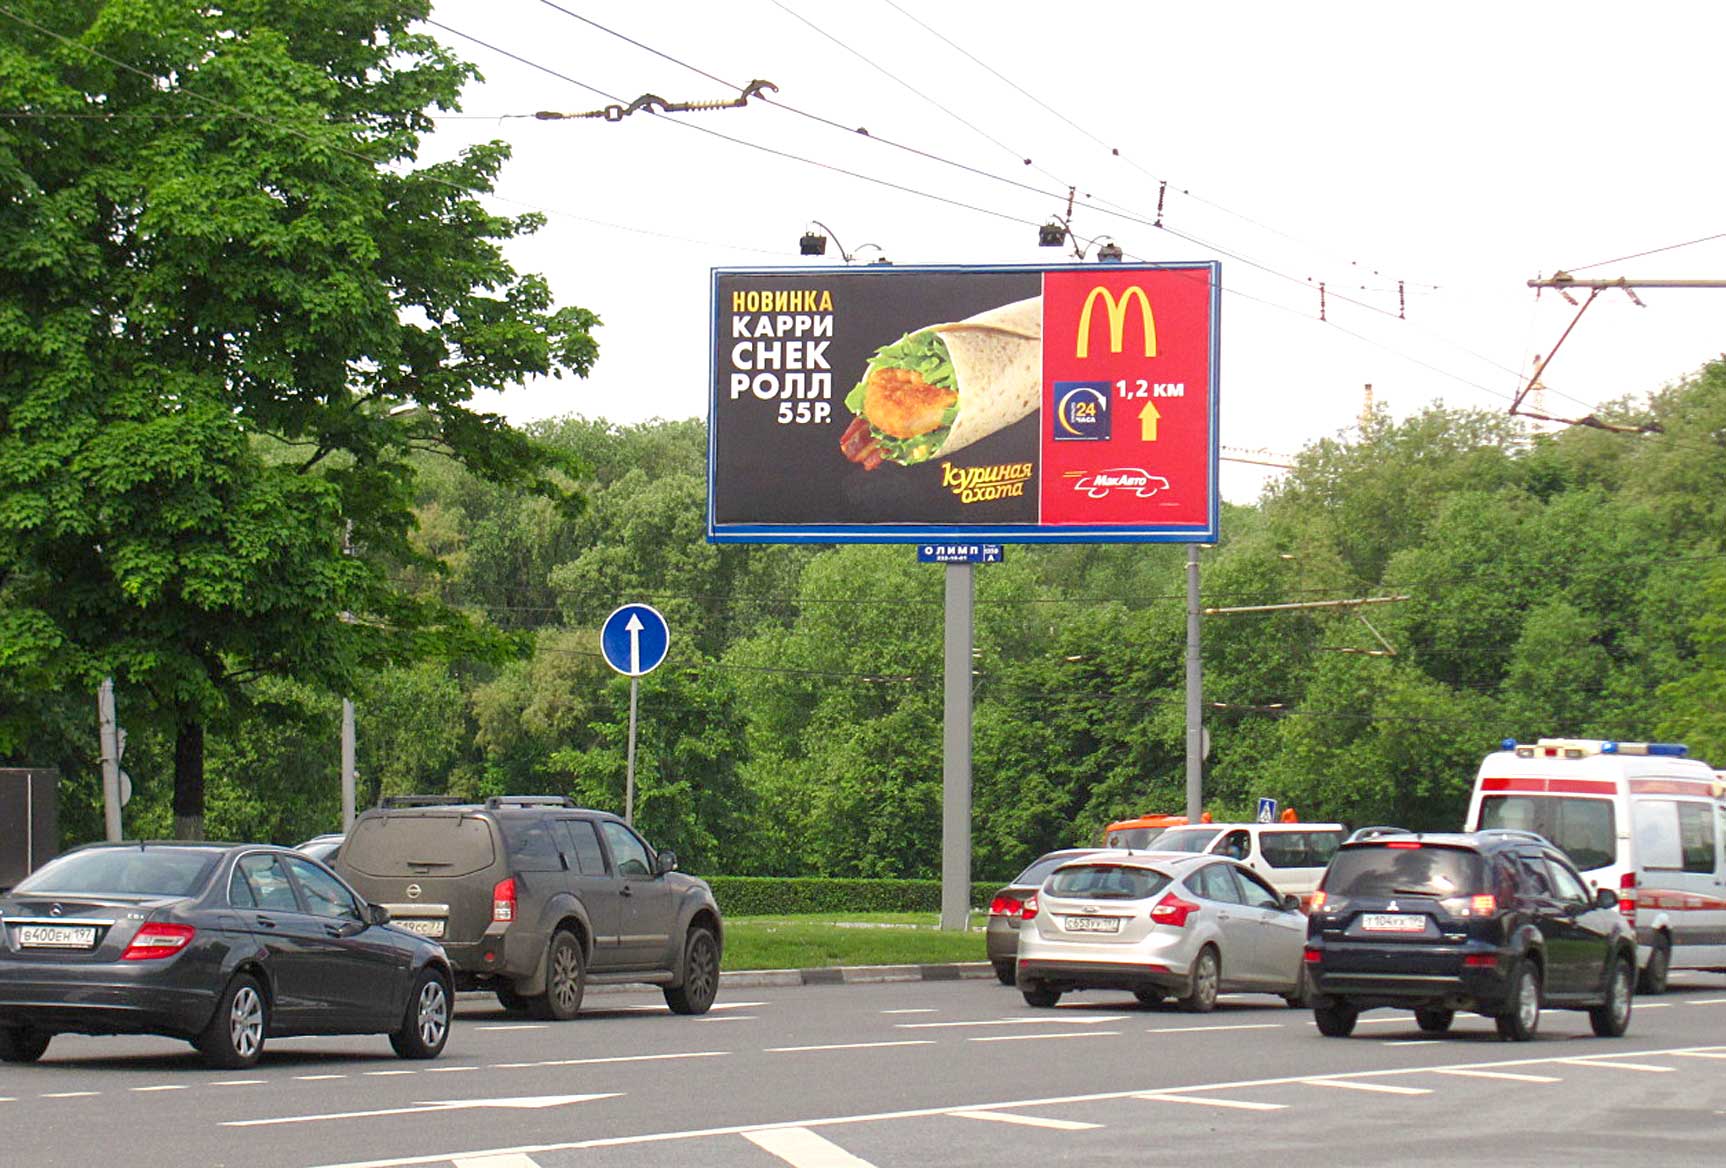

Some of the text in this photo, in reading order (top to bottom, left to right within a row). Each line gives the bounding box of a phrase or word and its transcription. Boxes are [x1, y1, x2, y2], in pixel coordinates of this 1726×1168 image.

[733, 290, 833, 312] НОВИНКА
[732, 314, 834, 338] КАРРИ
[731, 341, 832, 370] СНЕК
[730, 372, 832, 400] РОЛЛ
[1116, 379, 1149, 400] 1,2
[1076, 402, 1096, 417] 24
[961, 481, 1025, 504] охота
[924, 546, 979, 555] ОЛИМП
